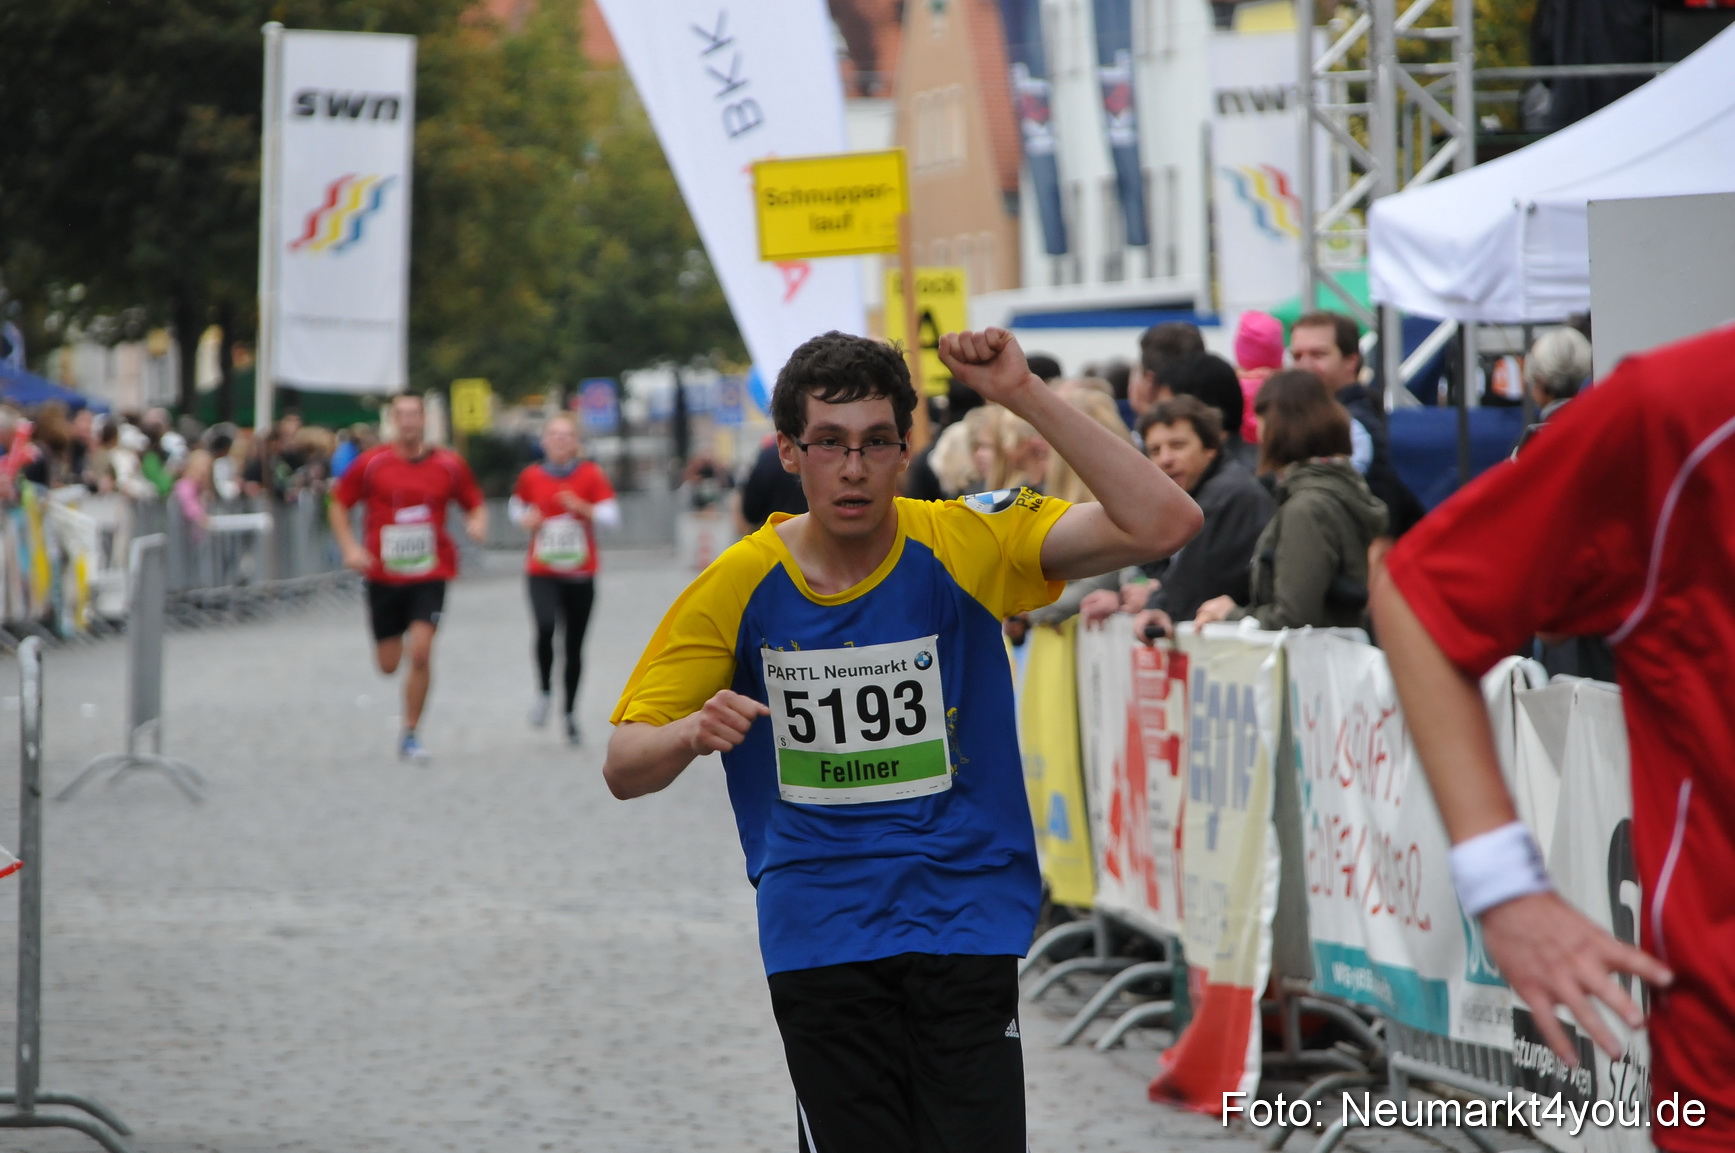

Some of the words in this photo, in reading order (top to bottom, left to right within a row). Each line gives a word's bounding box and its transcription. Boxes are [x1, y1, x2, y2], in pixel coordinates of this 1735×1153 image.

[688, 8, 765, 139] BKK
[294, 87, 401, 121] swn
[809, 209, 854, 232] lauf
[767, 663, 820, 681] PARTL
[824, 659, 908, 679] Neumarkt
[783, 679, 927, 745] 5193
[779, 737, 787, 747] S
[820, 759, 900, 783] Fellner
